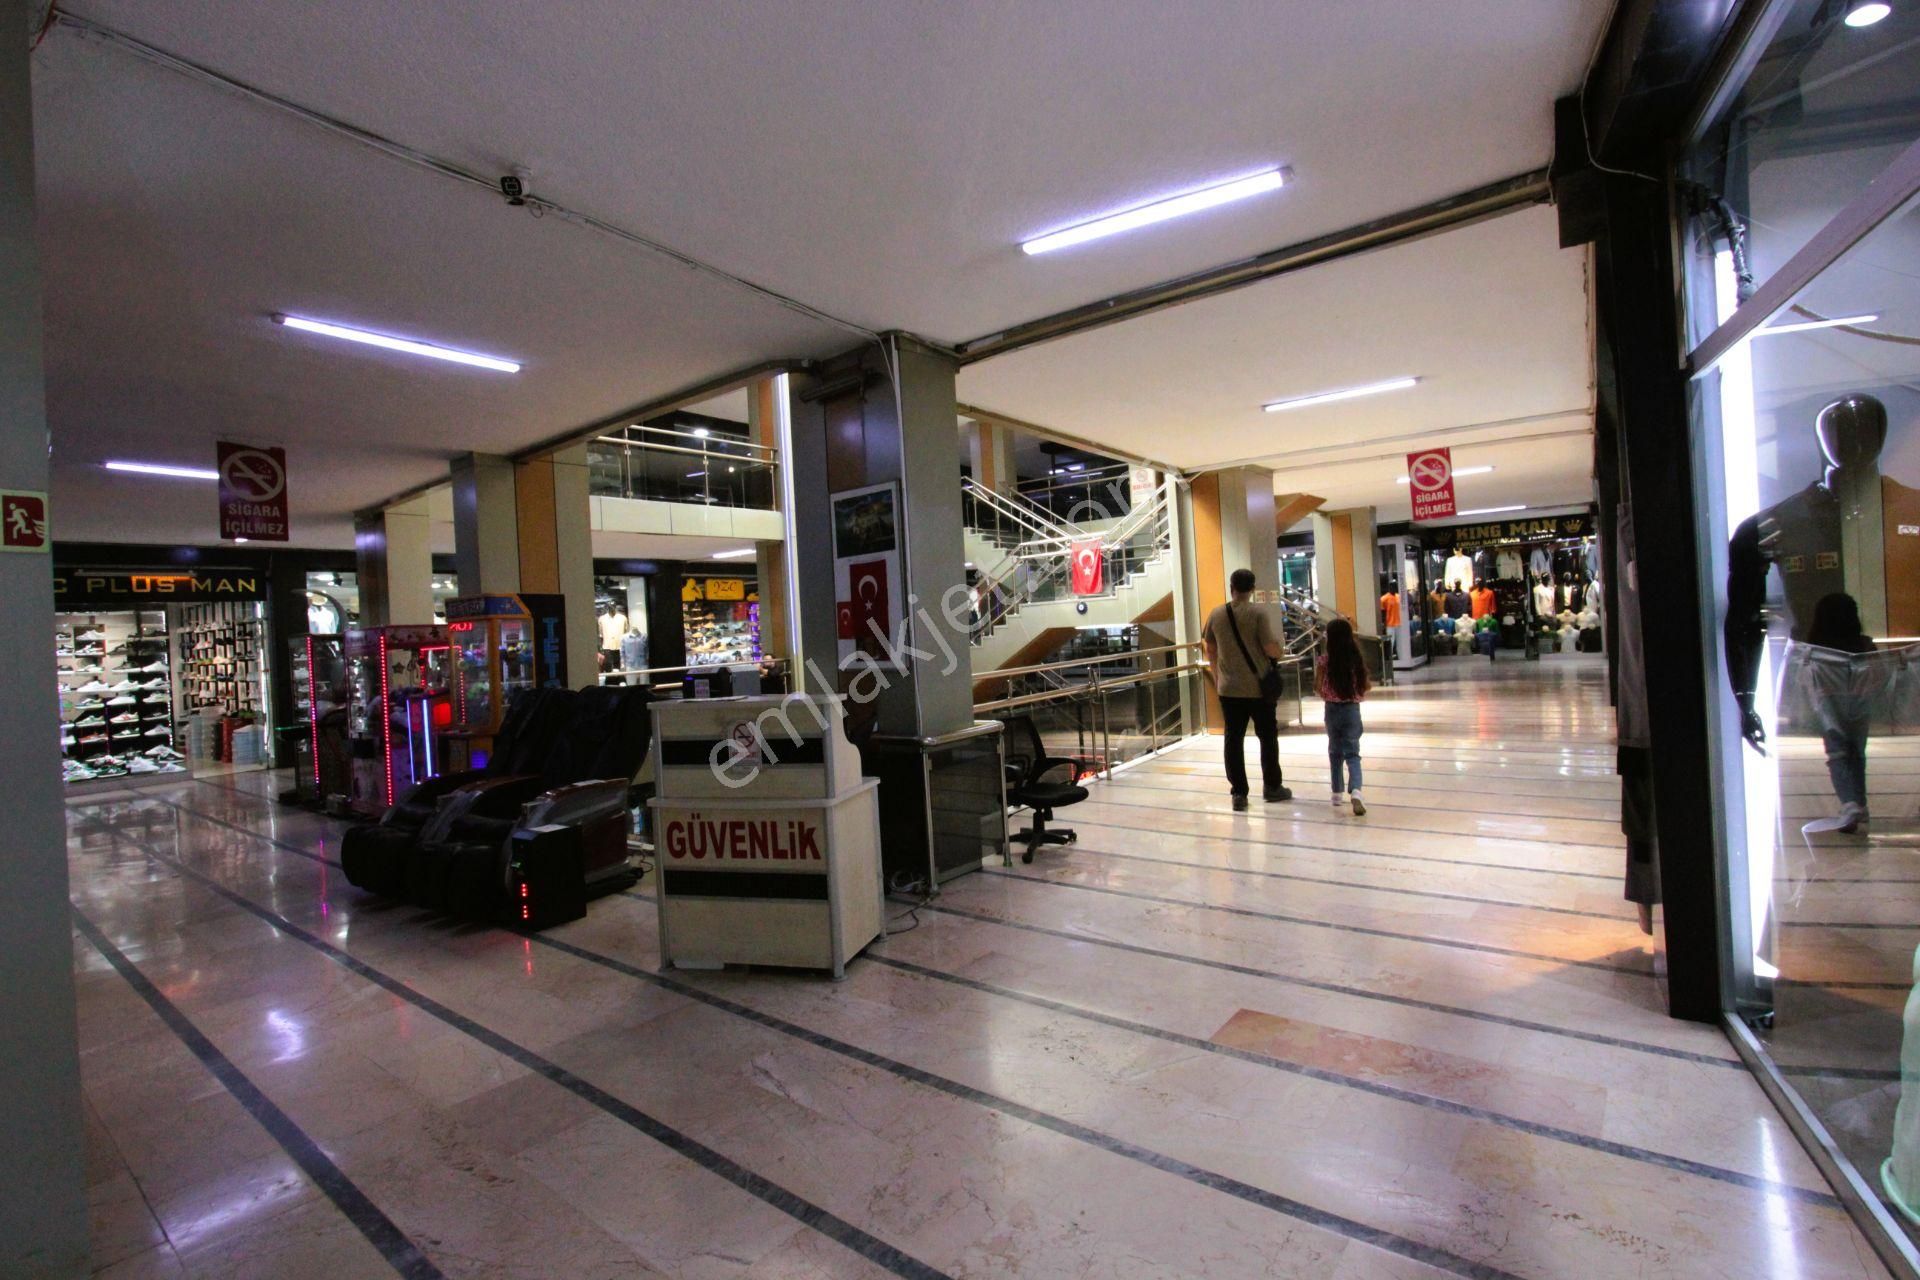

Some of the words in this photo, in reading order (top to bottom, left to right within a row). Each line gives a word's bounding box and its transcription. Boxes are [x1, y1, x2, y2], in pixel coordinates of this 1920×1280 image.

[1415, 502, 1454, 516] İÇİLMEZ
[226, 519, 285, 535] İÇİLMEZ
[1456, 525, 1501, 540] KING
[1509, 519, 1557, 535] MAN
[86, 576, 175, 593] PLUS
[191, 577, 256, 593] MAN
